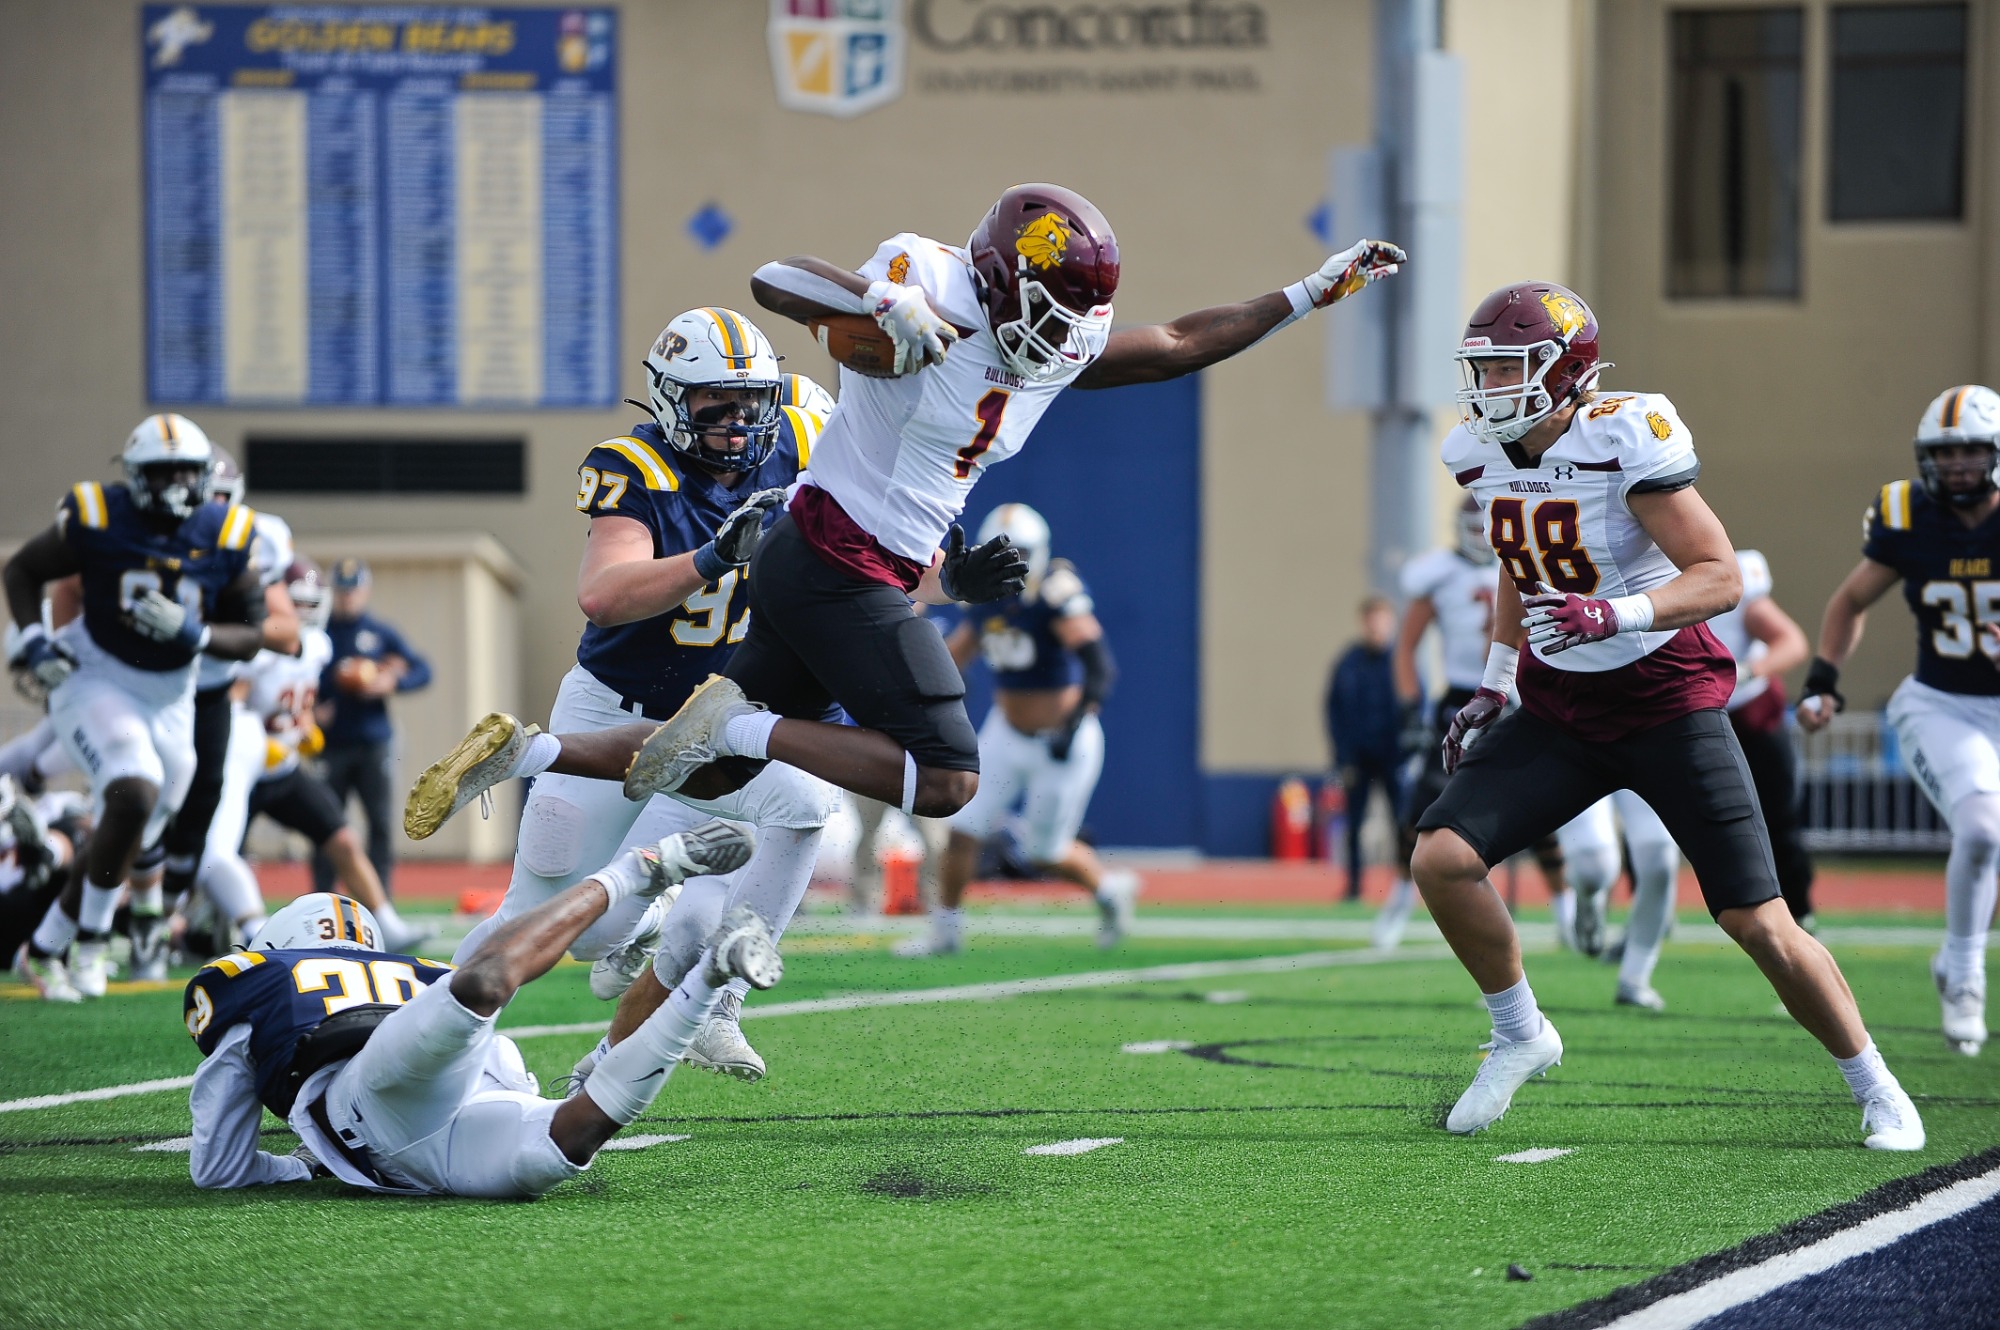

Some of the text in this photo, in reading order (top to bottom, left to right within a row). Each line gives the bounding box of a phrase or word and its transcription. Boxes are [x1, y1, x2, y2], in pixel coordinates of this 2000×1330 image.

[912, 0, 1270, 51] Concordia
[984, 366, 1025, 390] BULLDOGS
[953, 387, 1011, 480] 1
[575, 467, 629, 511] 97
[1509, 480, 1552, 494] BULLDOGS
[1490, 496, 1602, 597] 88
[1949, 558, 1991, 577] BEARS
